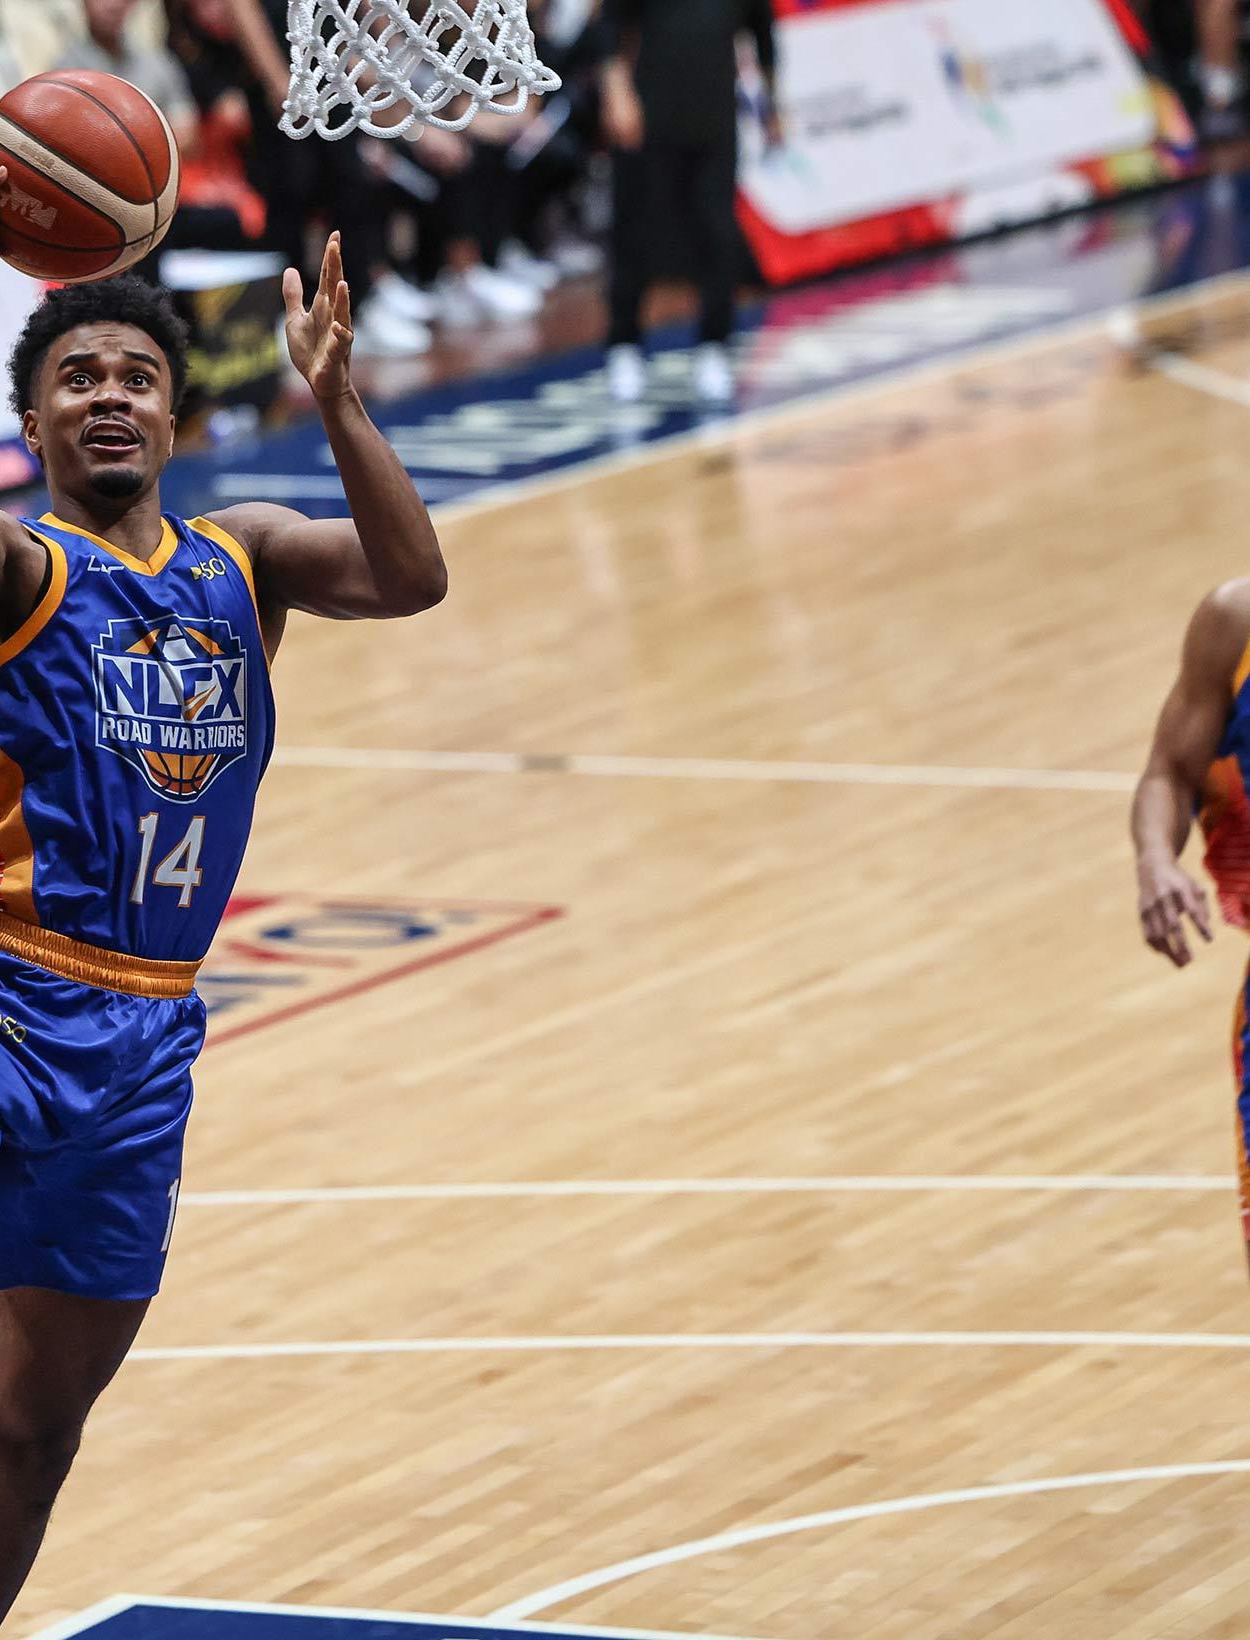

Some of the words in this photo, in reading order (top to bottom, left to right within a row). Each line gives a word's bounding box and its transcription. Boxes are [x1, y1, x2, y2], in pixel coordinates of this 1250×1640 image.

[102, 657, 243, 721] NLEX
[102, 716, 152, 745] ROAD
[159, 724, 245, 750] WARRIORS
[129, 811, 206, 908] 14
